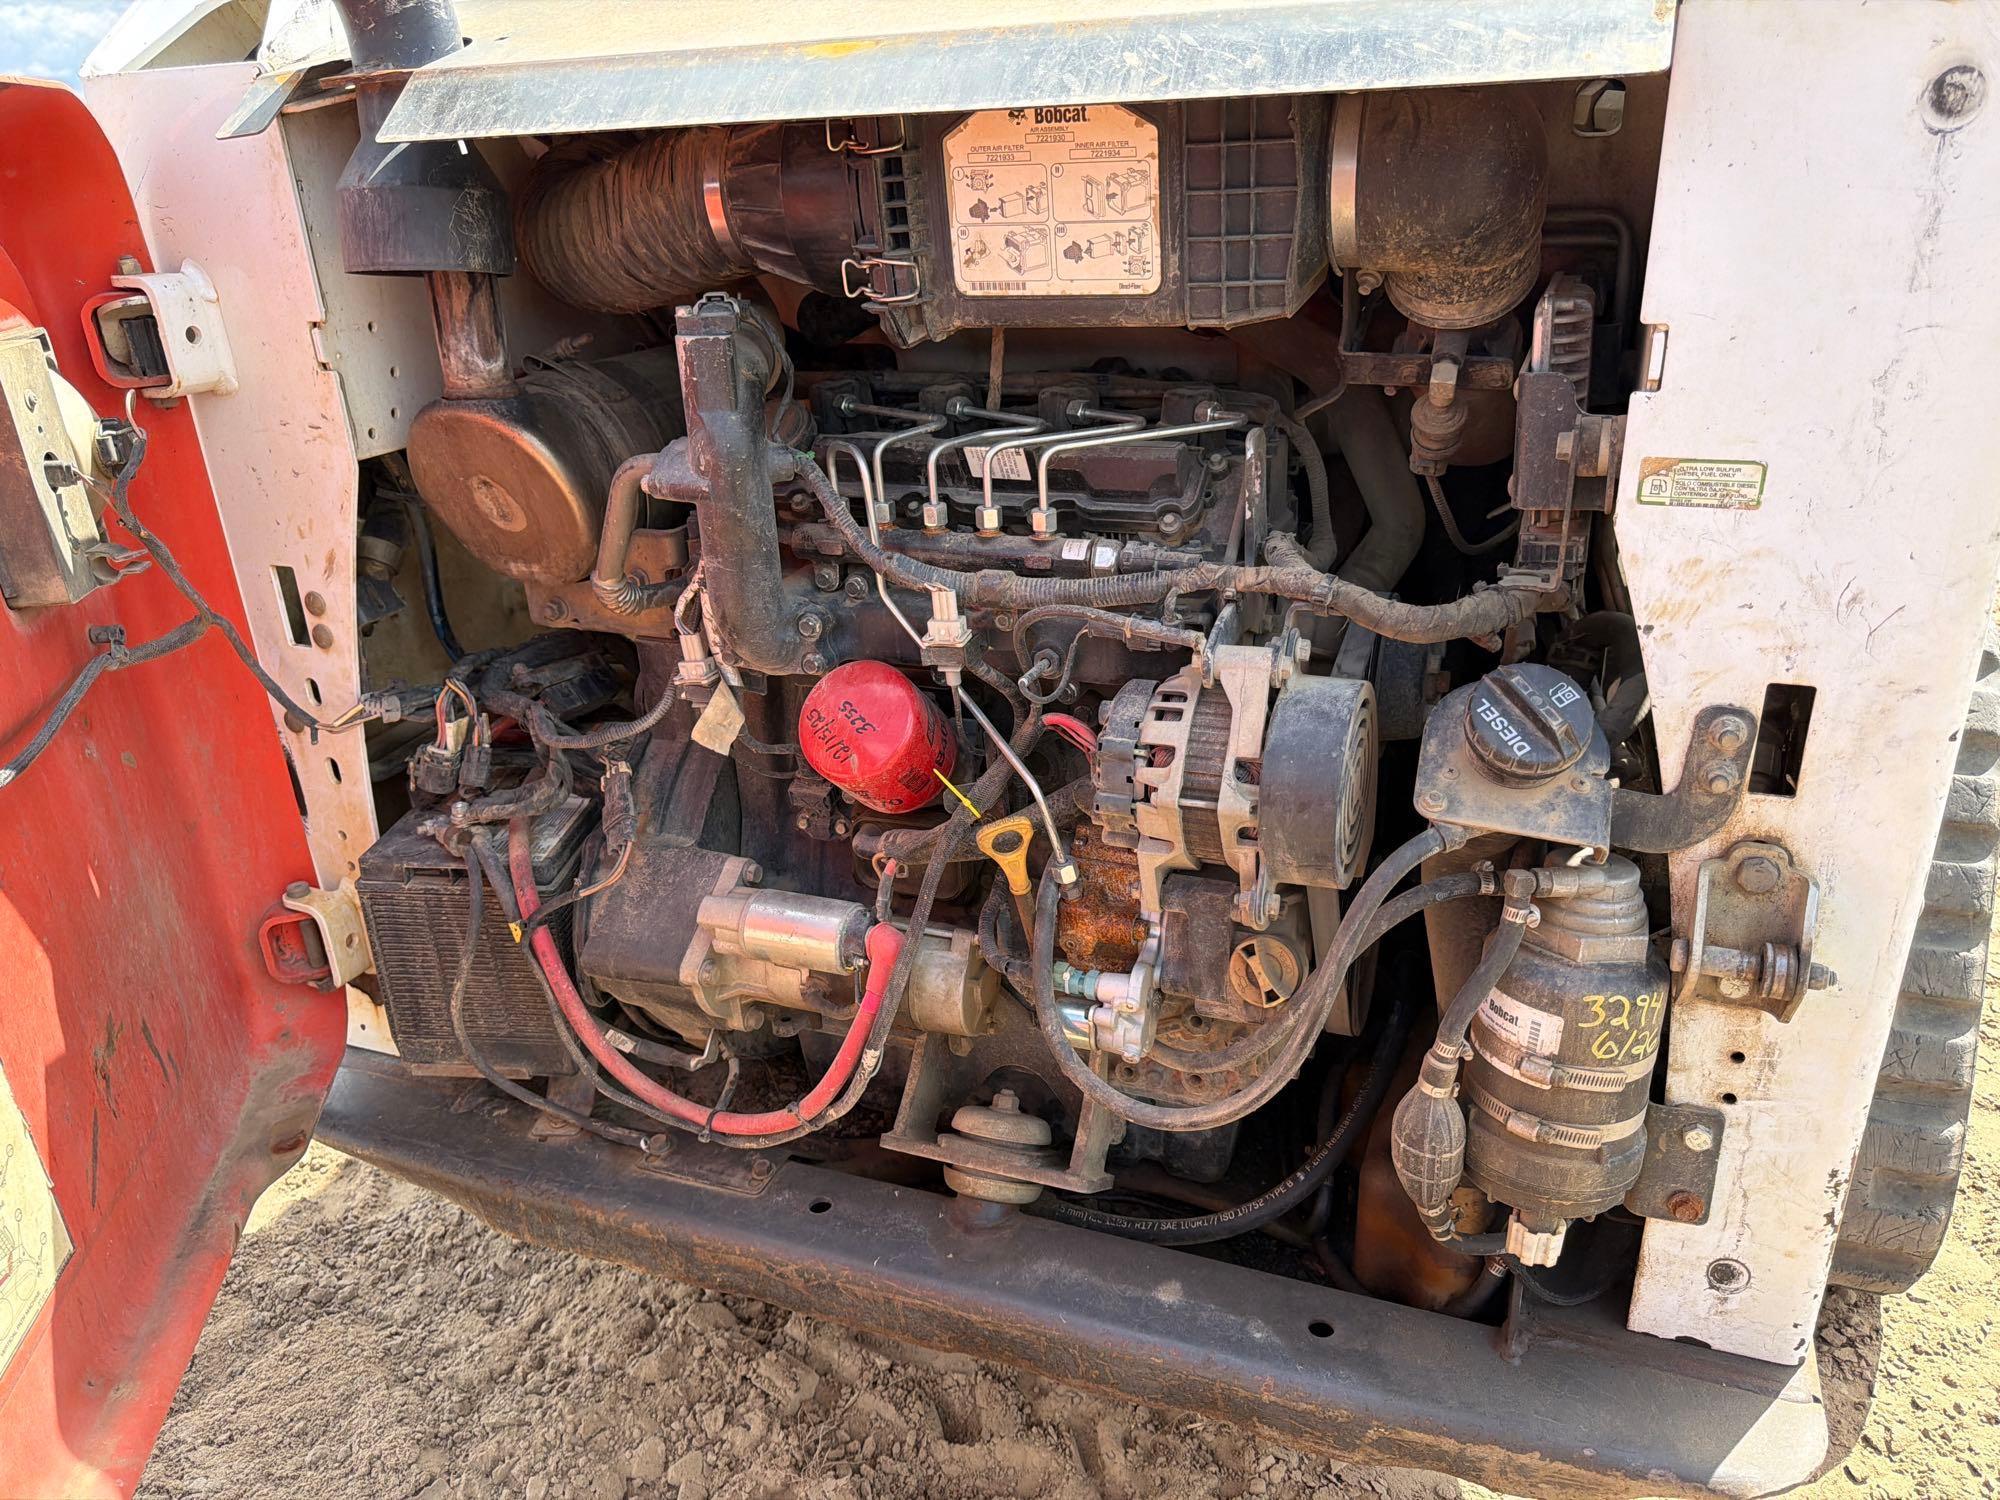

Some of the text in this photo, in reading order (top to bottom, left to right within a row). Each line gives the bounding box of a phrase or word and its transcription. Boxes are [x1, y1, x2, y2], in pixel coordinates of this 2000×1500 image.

[1034, 106, 1087, 124] Bobcat
[1036, 134, 1065, 142] 7221930
[1074, 141, 1095, 149] INNER
[1107, 140, 1130, 148] FILTER
[985, 153, 1015, 162] 7221933
[1090, 149, 1121, 158] 7221934
[838, 700, 877, 734] 3255
[1476, 698, 1532, 757] DIESEL
[1488, 999, 1520, 1028] Bobcat
[1578, 991, 1664, 1031] 3294
[1591, 1027, 1660, 1061] 6/26
[1160, 1220, 1178, 1231] SAE
[1219, 1210, 1235, 1222] ISO
